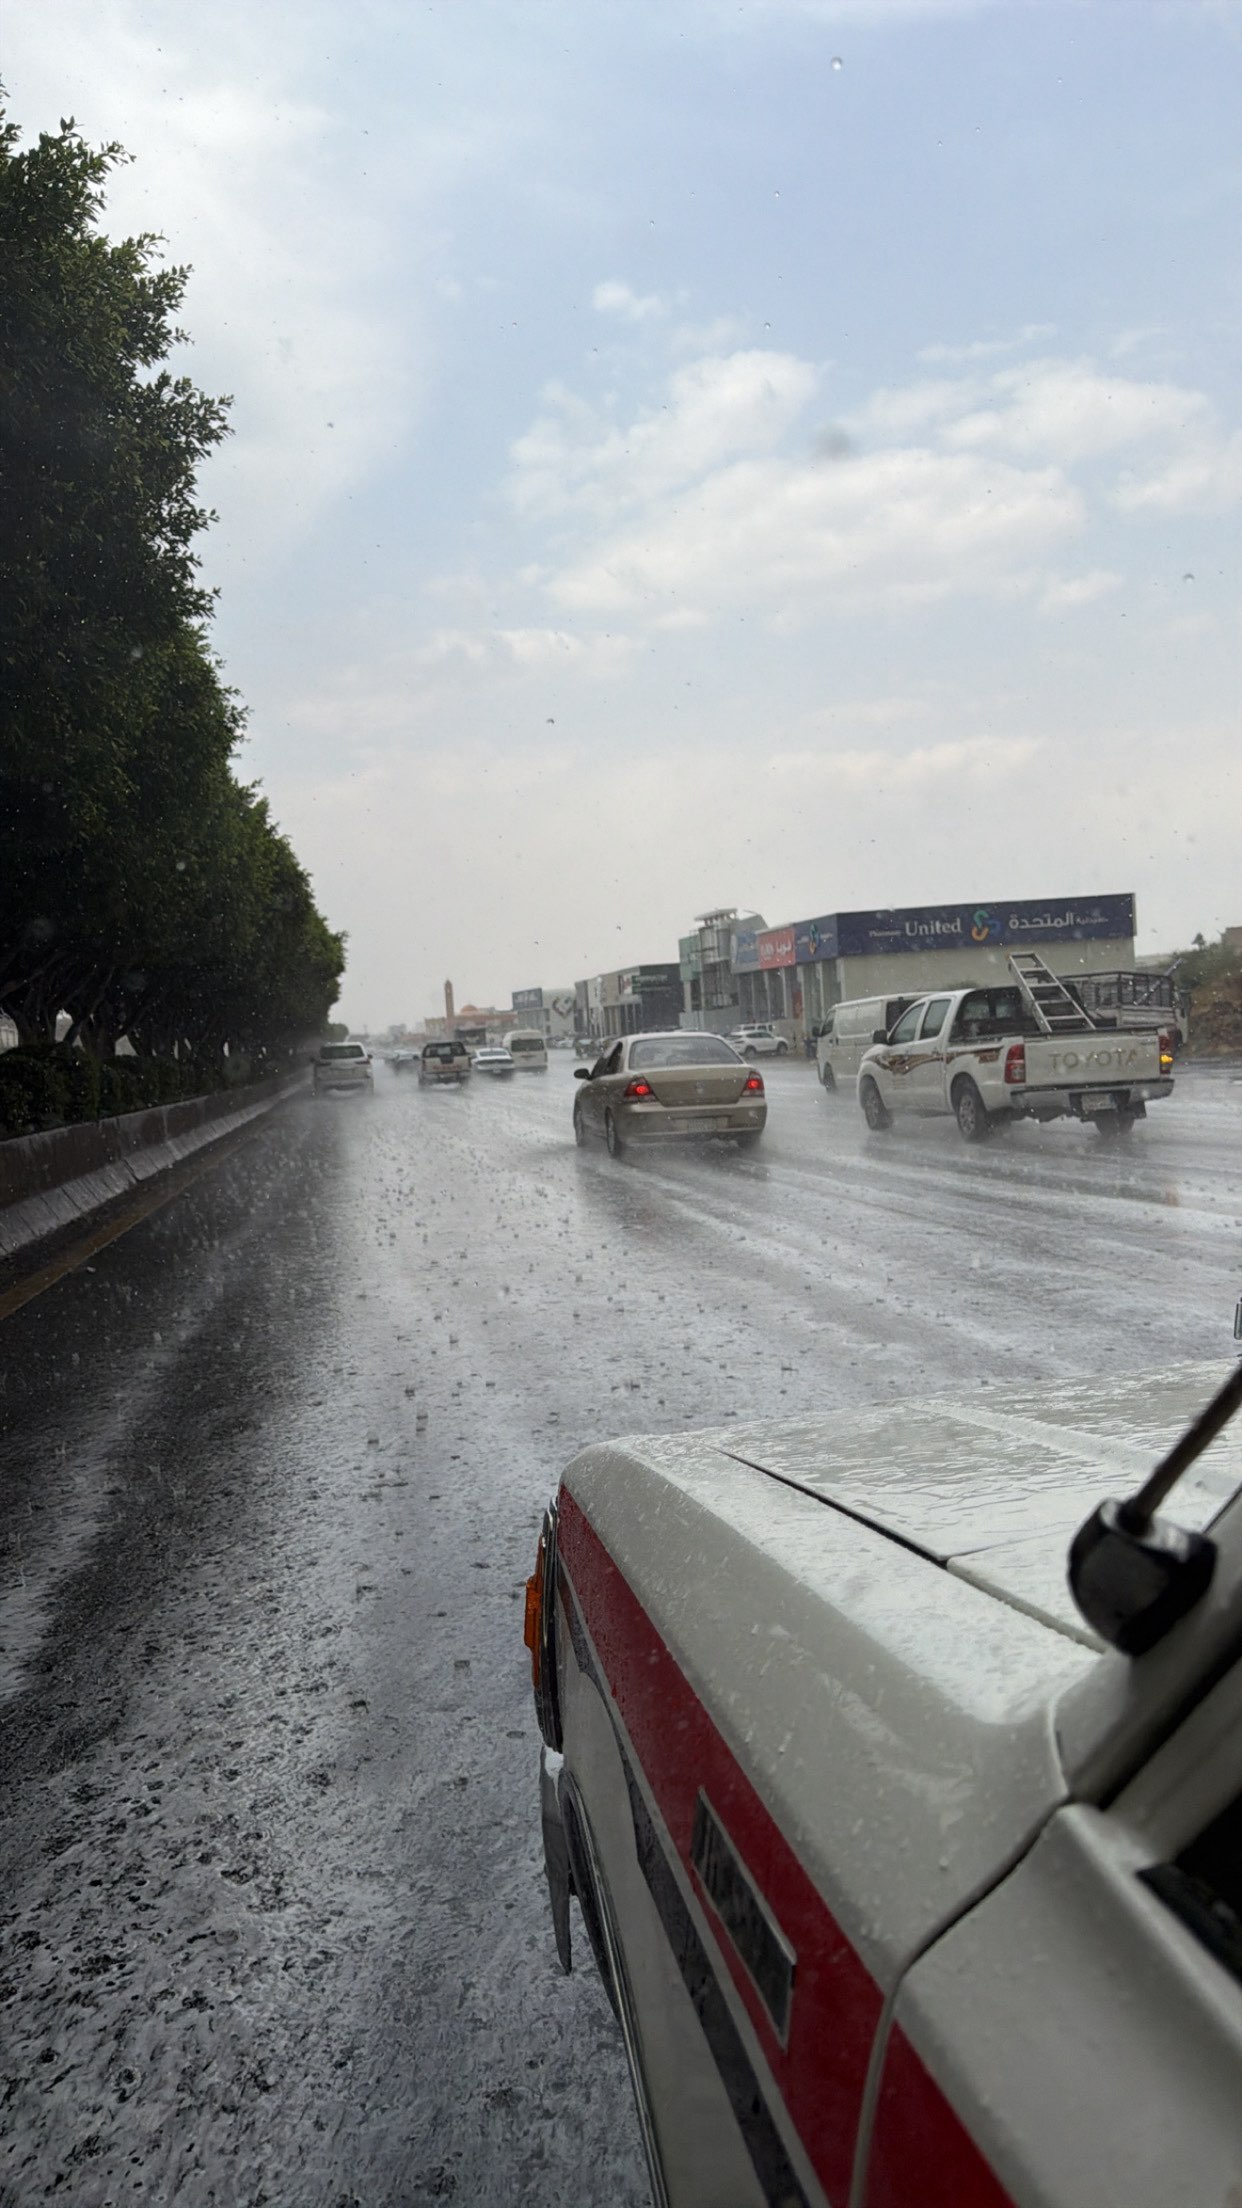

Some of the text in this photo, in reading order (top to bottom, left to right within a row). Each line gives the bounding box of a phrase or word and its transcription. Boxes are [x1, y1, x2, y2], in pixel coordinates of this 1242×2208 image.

[905, 917, 962, 937] United
[1008, 911, 1074, 930] المتحدة
[1048, 1048, 1138, 1070] TOYOTA
